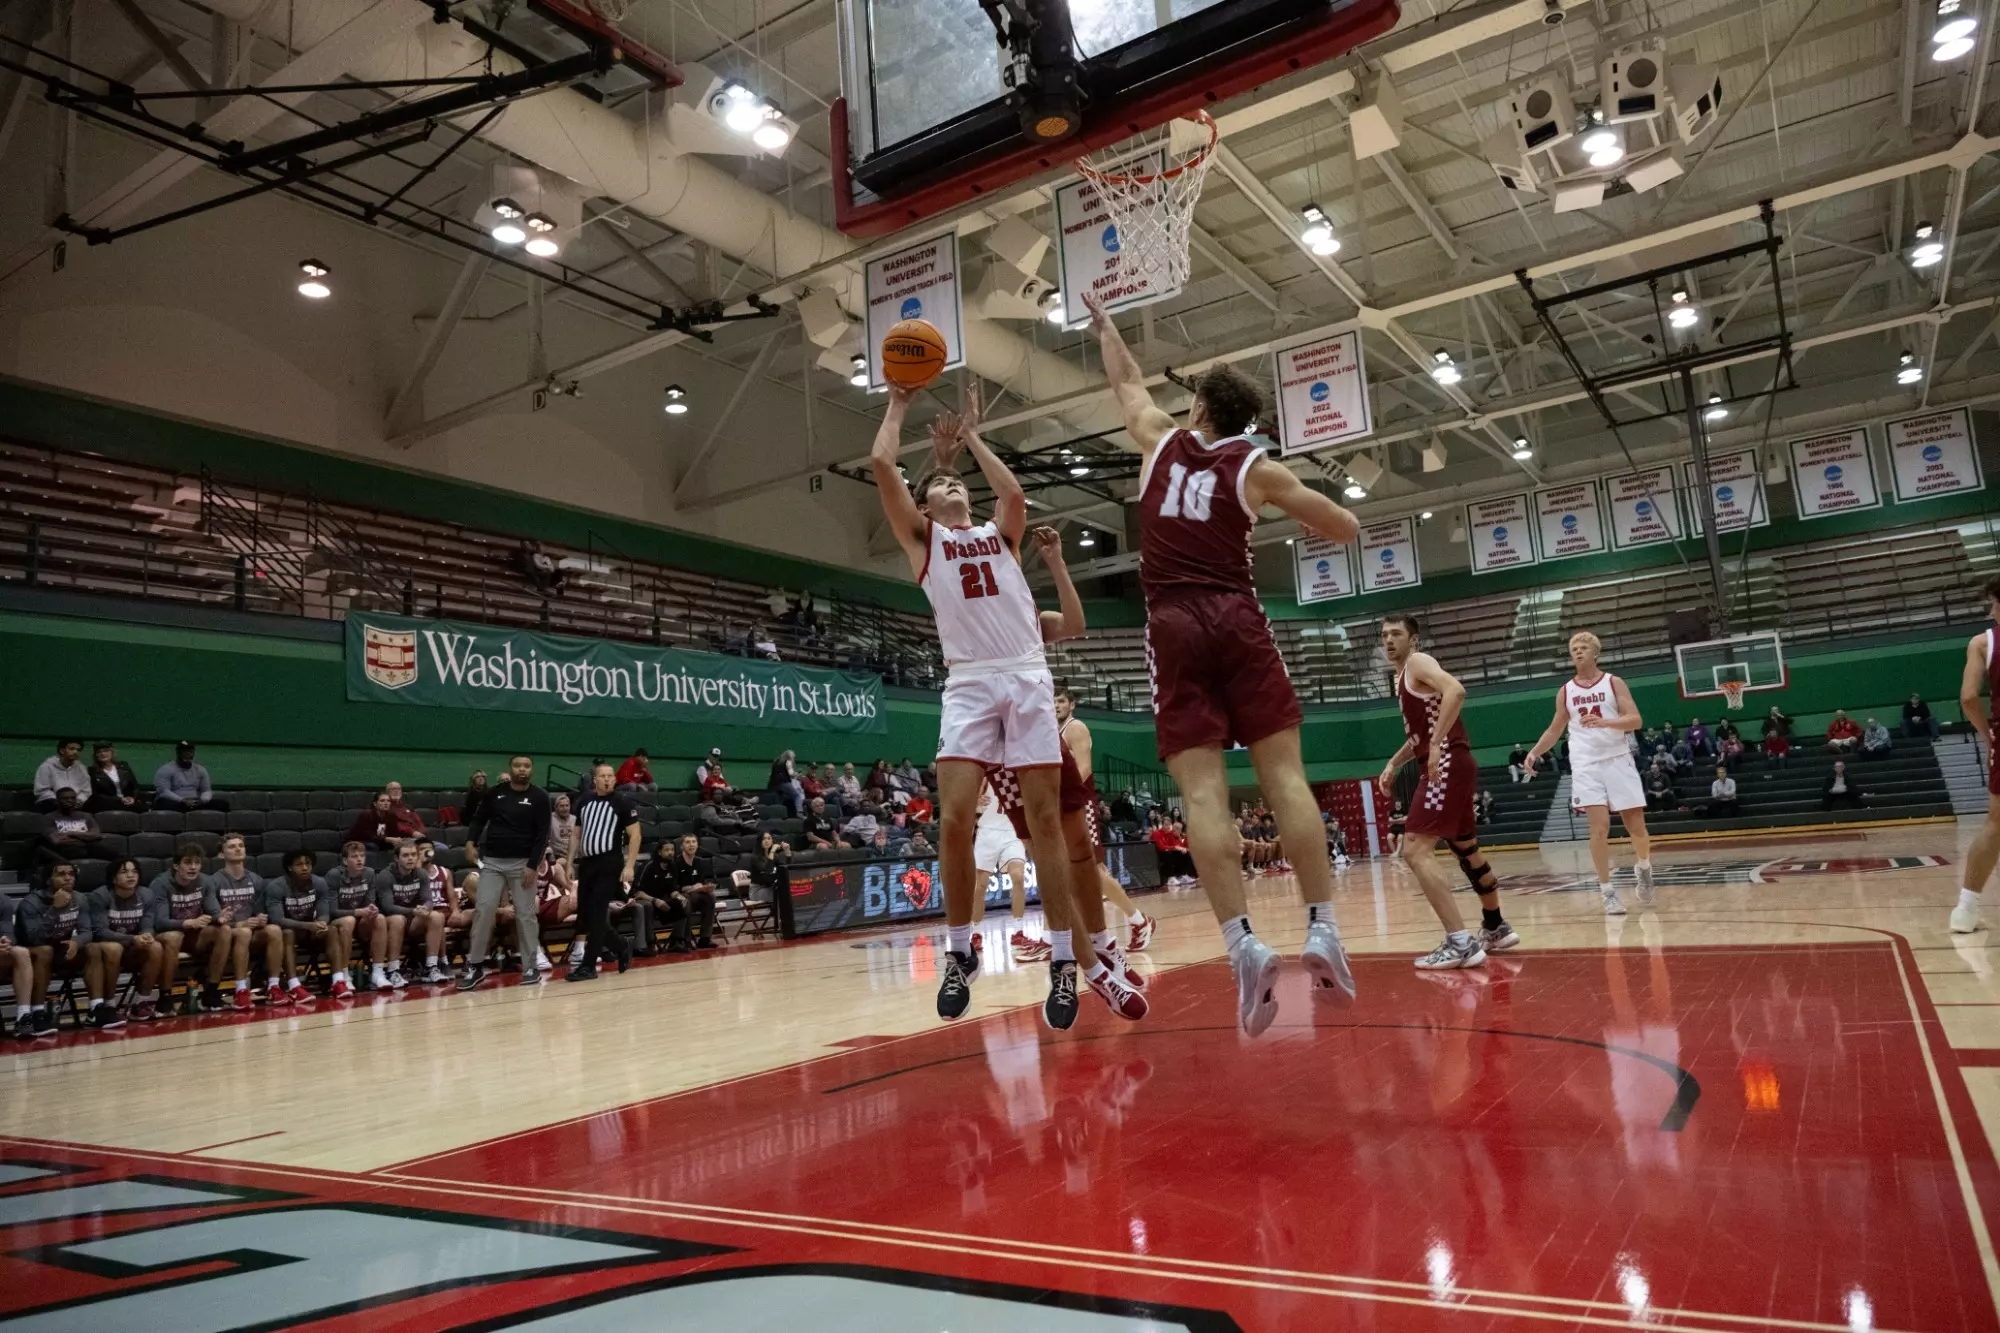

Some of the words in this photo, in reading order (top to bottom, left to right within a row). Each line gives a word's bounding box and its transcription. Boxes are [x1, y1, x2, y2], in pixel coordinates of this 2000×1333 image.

[1064, 216, 1092, 235] WOMEN'S
[883, 246, 937, 272] WASHINGTON
[886, 262, 935, 286] UNIVERSITY
[917, 278, 934, 292] TRACK
[938, 272, 954, 283] FIELD
[1292, 343, 1341, 362] WASHINGTON
[1296, 355, 1340, 372] UNIVERSITY
[1319, 369, 1336, 380] TRACK
[1342, 363, 1357, 374] FIELD
[1312, 402, 1332, 414] 2022
[1306, 412, 1342, 426] NATIONAL
[1902, 414, 1952, 428] WASHINGTON
[1303, 420, 1348, 438] CHAMPIONS
[1906, 424, 1952, 438] UNIVERSITY
[1804, 436, 1852, 448] WASHINGTON
[1896, 438, 1923, 448] WOMEN'S
[1924, 432, 1963, 444] VOLLEYBALL
[1808, 444, 1851, 457] UNIVERSITY
[1800, 458, 1826, 468] WOMEN'S
[1827, 452, 1863, 462] VOLLEYBALL
[1918, 472, 1956, 484] NATIONAL
[1159, 462, 1218, 522] 10
[1547, 486, 1584, 498] WASHINGTON
[1916, 480, 1960, 493] CHAMPIONS
[1549, 495, 1584, 506] UNIVERSITY
[1820, 490, 1855, 501] NATIONAL
[1478, 500, 1516, 511] WASHINGTON
[1818, 498, 1860, 510] CHAMPIONS
[1482, 508, 1514, 518] UNIVERSITY
[1368, 522, 1402, 534] WASHINGTON
[1630, 522, 1662, 533] NATIONAL
[1370, 531, 1400, 542] UNIVERSITY
[1557, 536, 1586, 546] NATIONAL
[1629, 530, 1666, 542] CHAMPIONS
[942, 536, 1001, 561] WashU
[1488, 548, 1516, 558] NATIONAL
[1556, 544, 1590, 554] CHAMPIONS
[1486, 556, 1520, 566] CHAMPIONS
[1376, 570, 1402, 578] NATIONAL
[959, 562, 999, 599] 21
[1312, 580, 1337, 589] NATIONAL
[1374, 576, 1404, 586] CHAMPIONS
[1310, 588, 1340, 597] CHAMPIONS
[422, 630, 641, 705] Washington
[636, 660, 769, 719] University
[771, 678, 798, 713] in
[1572, 692, 1605, 706] WashU
